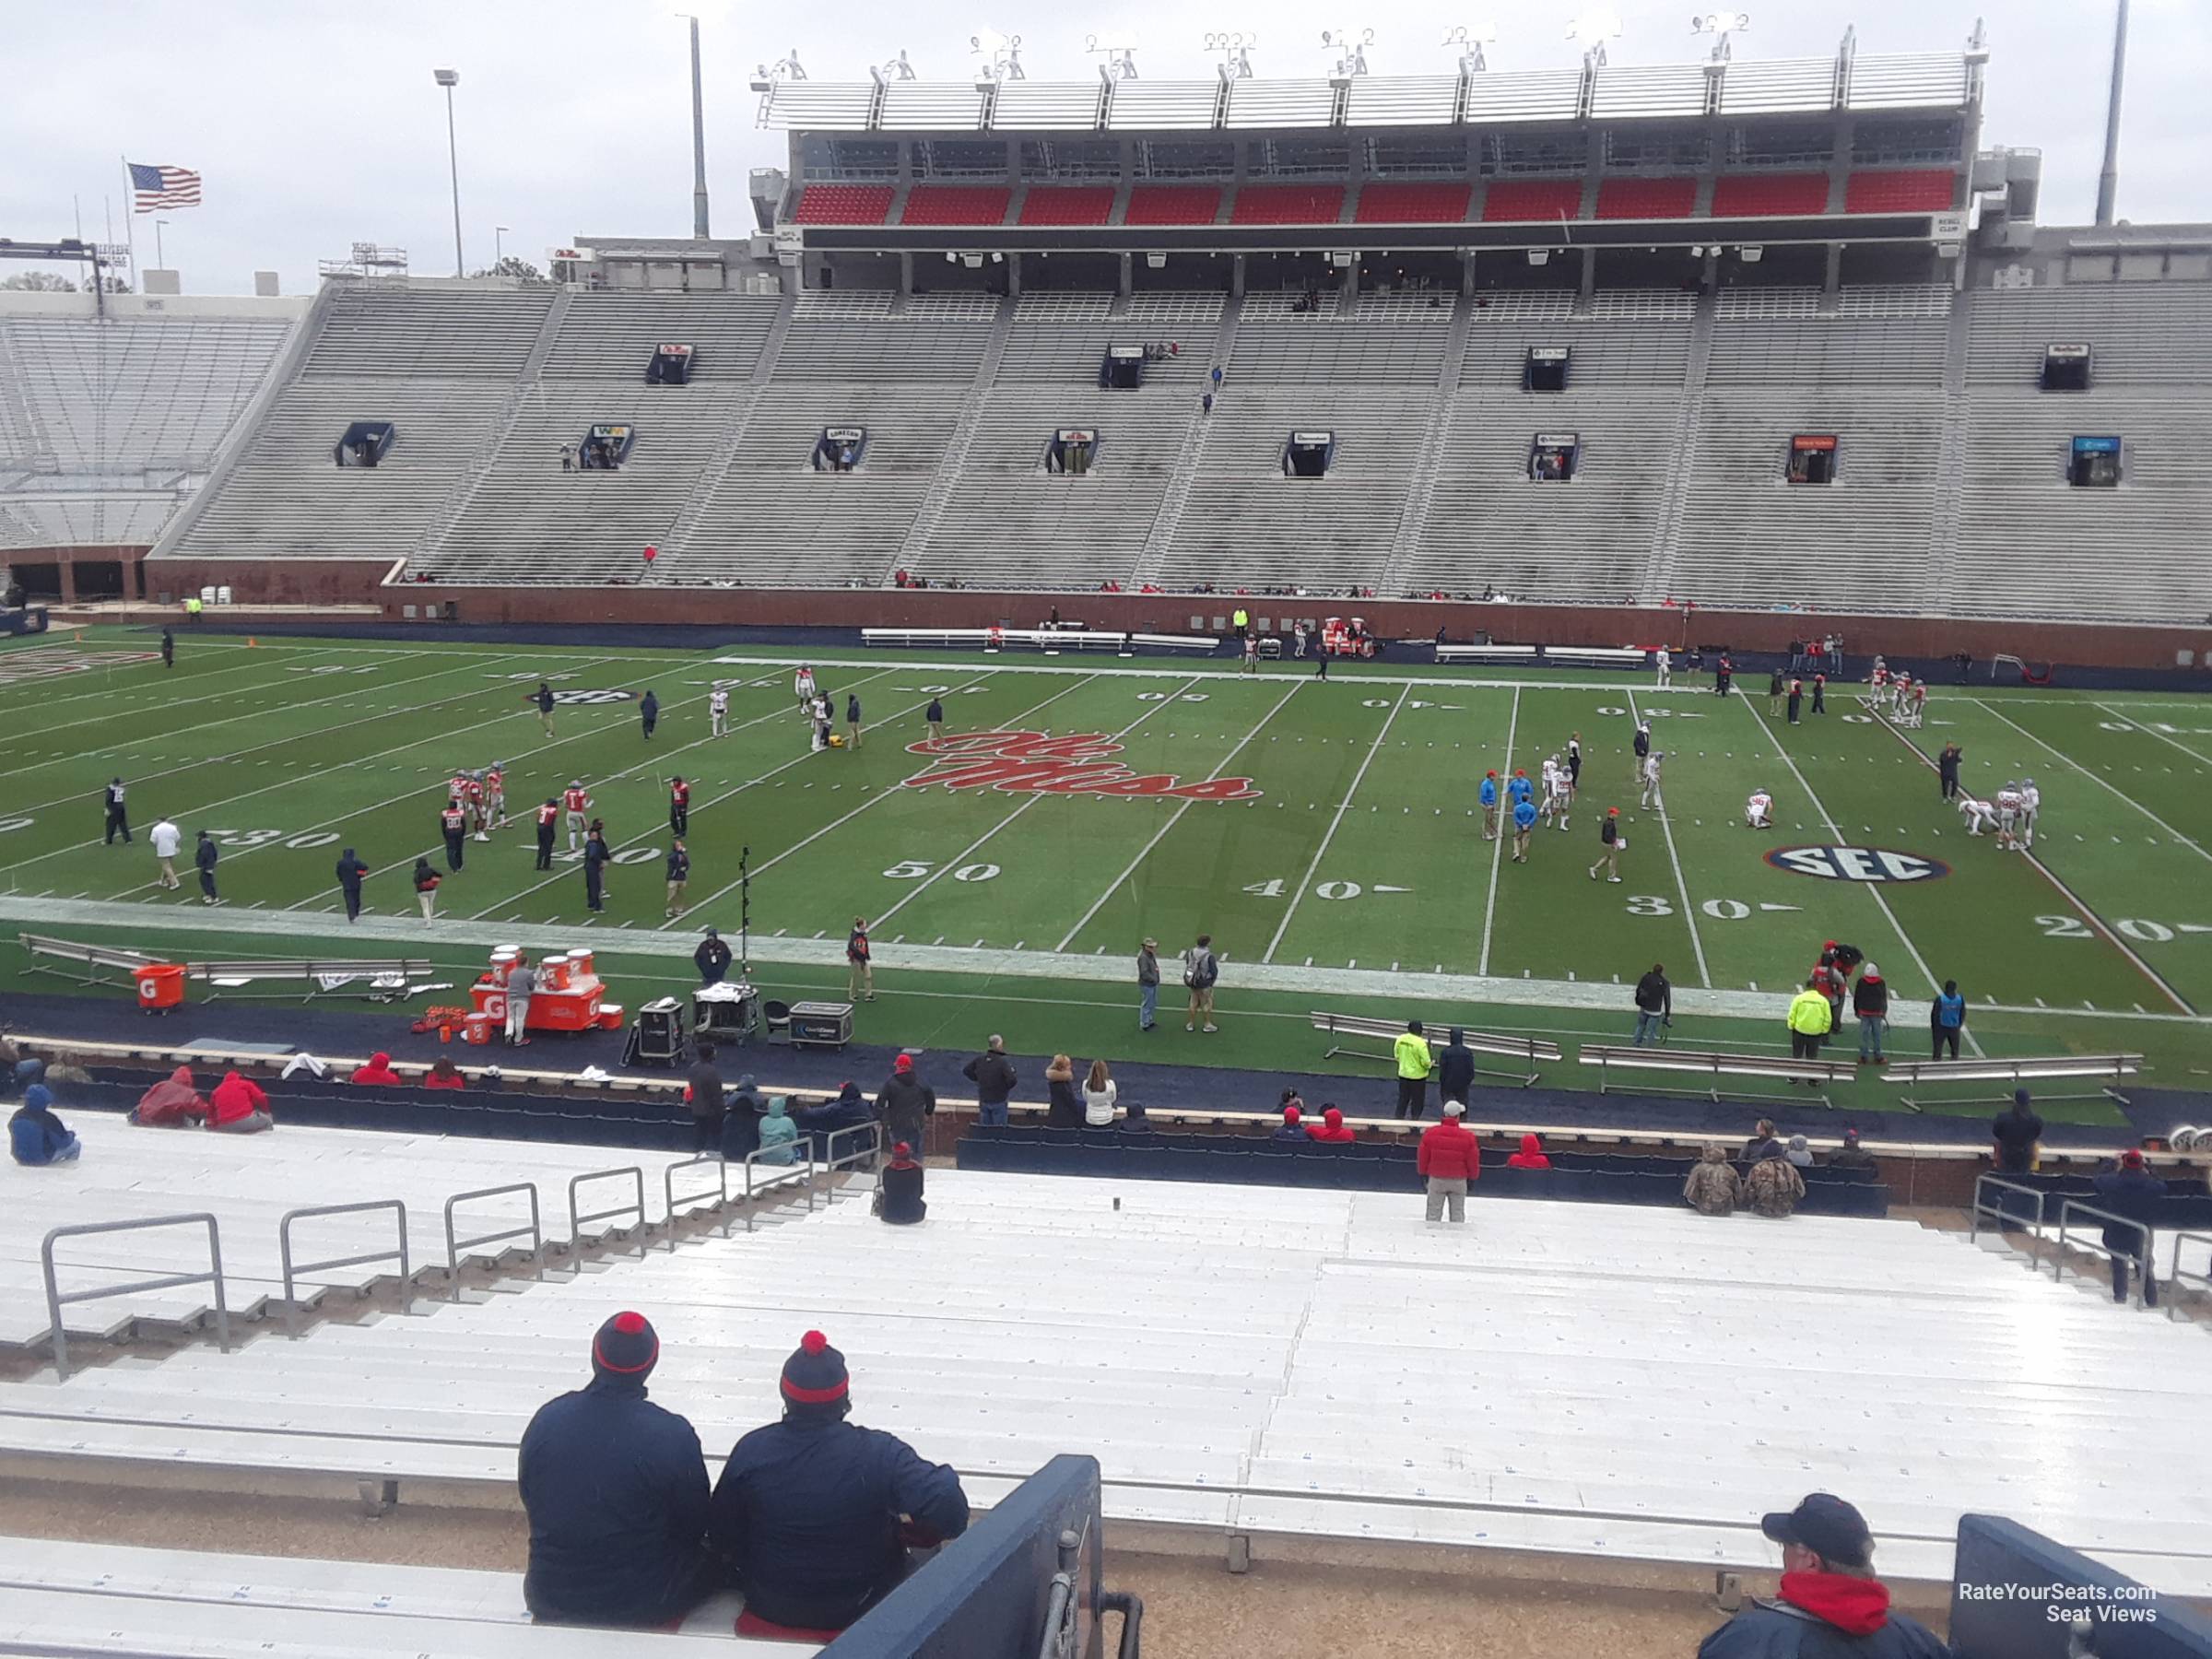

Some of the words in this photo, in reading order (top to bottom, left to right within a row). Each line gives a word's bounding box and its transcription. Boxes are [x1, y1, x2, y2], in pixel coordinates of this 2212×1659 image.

[1780, 847, 1932, 881] SEC
[140, 979, 157, 999] G
[484, 995, 505, 1019] G
